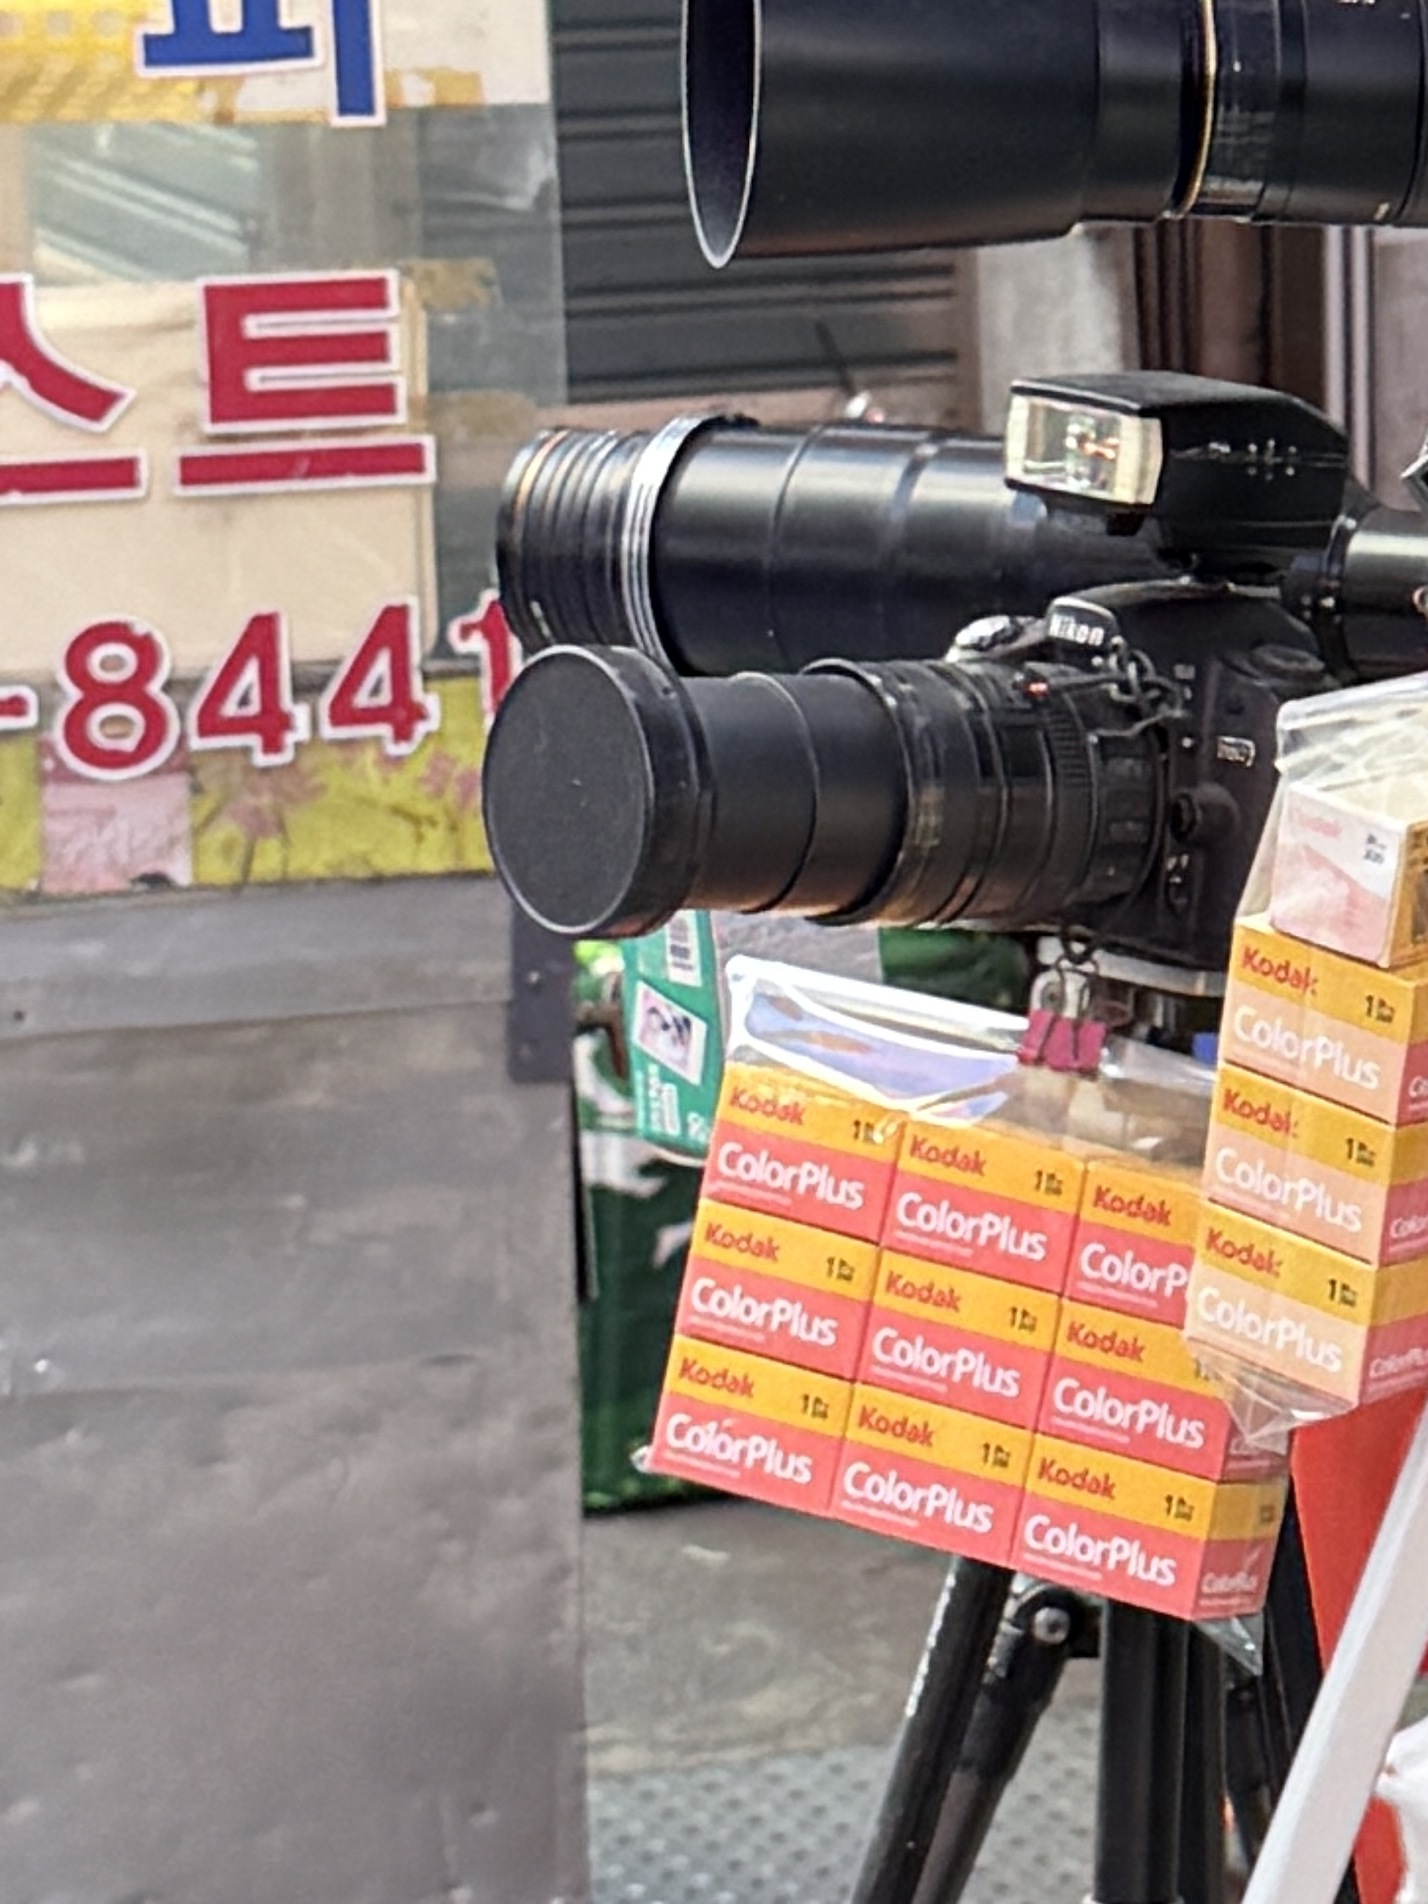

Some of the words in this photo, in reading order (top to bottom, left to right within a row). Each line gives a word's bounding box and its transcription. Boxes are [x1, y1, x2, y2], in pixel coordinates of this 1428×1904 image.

[1049, 612, 1105, 647] Nikon
[1233, 1004, 1381, 1091] ColorPlus
[729, 1086, 807, 1126] Kodak
[717, 1141, 865, 1210] ColorPlus
[908, 1134, 987, 1177] Kodak
[1092, 1185, 1173, 1228] Kodak
[1214, 1146, 1363, 1234] ColorPlus
[704, 1221, 781, 1263] Kodak
[896, 1191, 1048, 1262] ColorPlus
[884, 1269, 963, 1313] Kodak
[1080, 1242, 1188, 1297] ColorP
[690, 1277, 839, 1347] ColorPlus
[1066, 1320, 1147, 1363] Kodak
[1198, 1285, 1343, 1374] ColorPlus
[677, 1356, 755, 1399] Kodak
[871, 1326, 1022, 1398] ColorPlus
[858, 1404, 936, 1448] Kodak
[1052, 1376, 1205, 1449] ColorPlus
[665, 1412, 813, 1485] ColorPlus
[1037, 1456, 1117, 1502] Kodak
[842, 1461, 994, 1534] ColorPlus
[1023, 1515, 1177, 1588] ColorPlus
